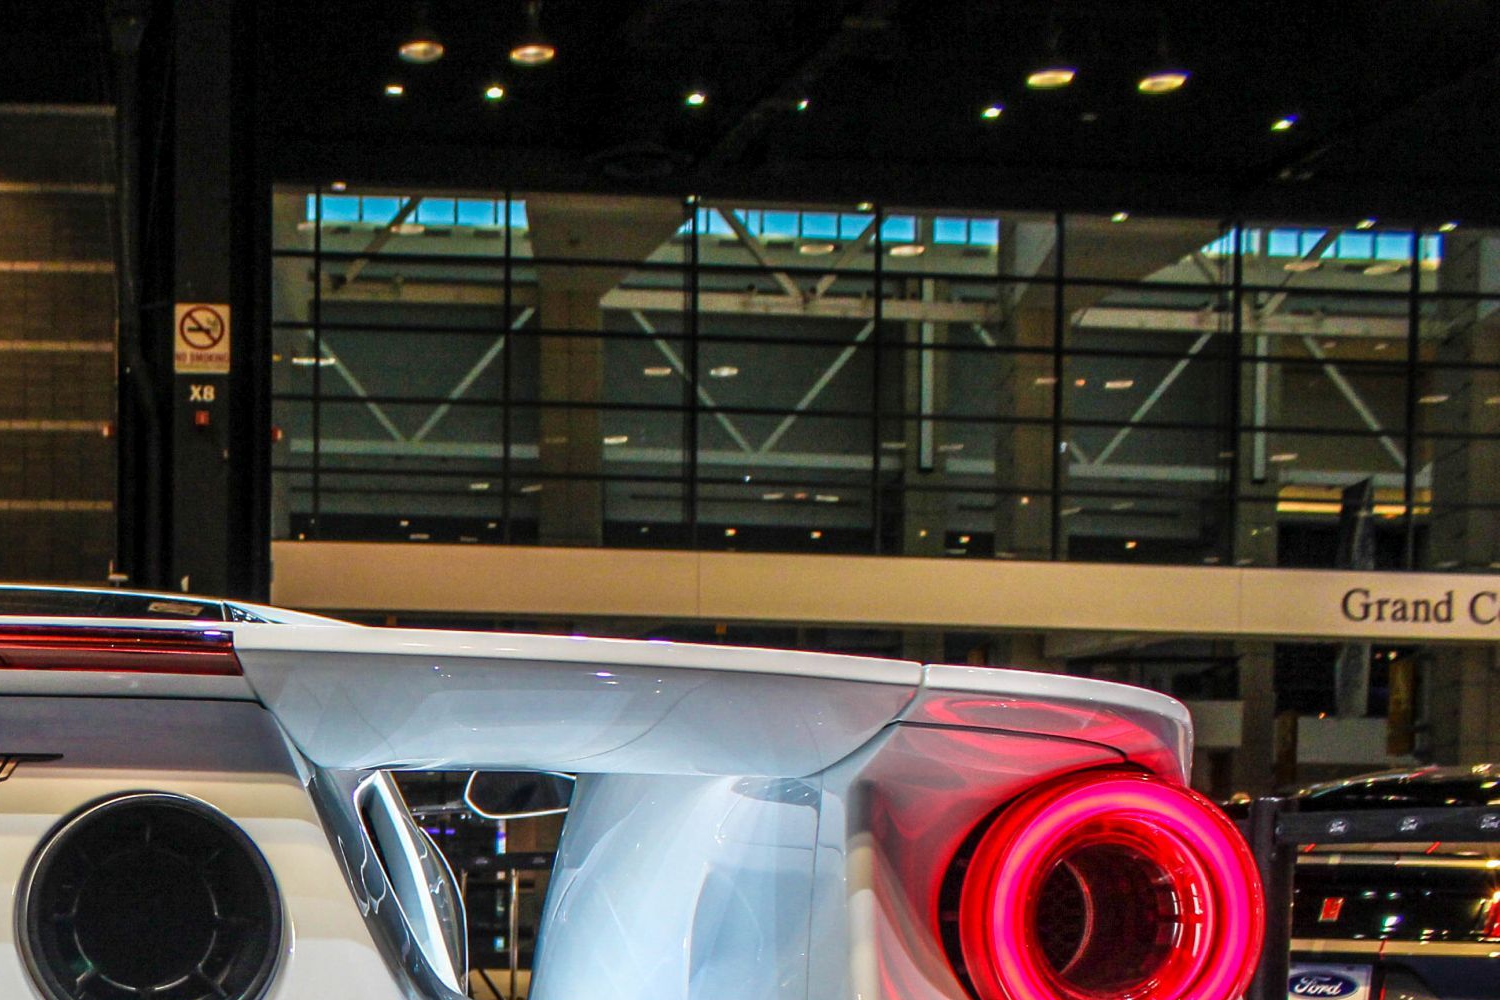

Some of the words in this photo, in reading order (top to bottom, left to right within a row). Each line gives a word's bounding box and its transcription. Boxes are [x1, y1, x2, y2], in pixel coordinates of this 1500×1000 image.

[189, 384, 215, 402] X8
[1341, 587, 1453, 624] Grand
[1468, 591, 1500, 625] C
[1294, 976, 1343, 996] Ford
